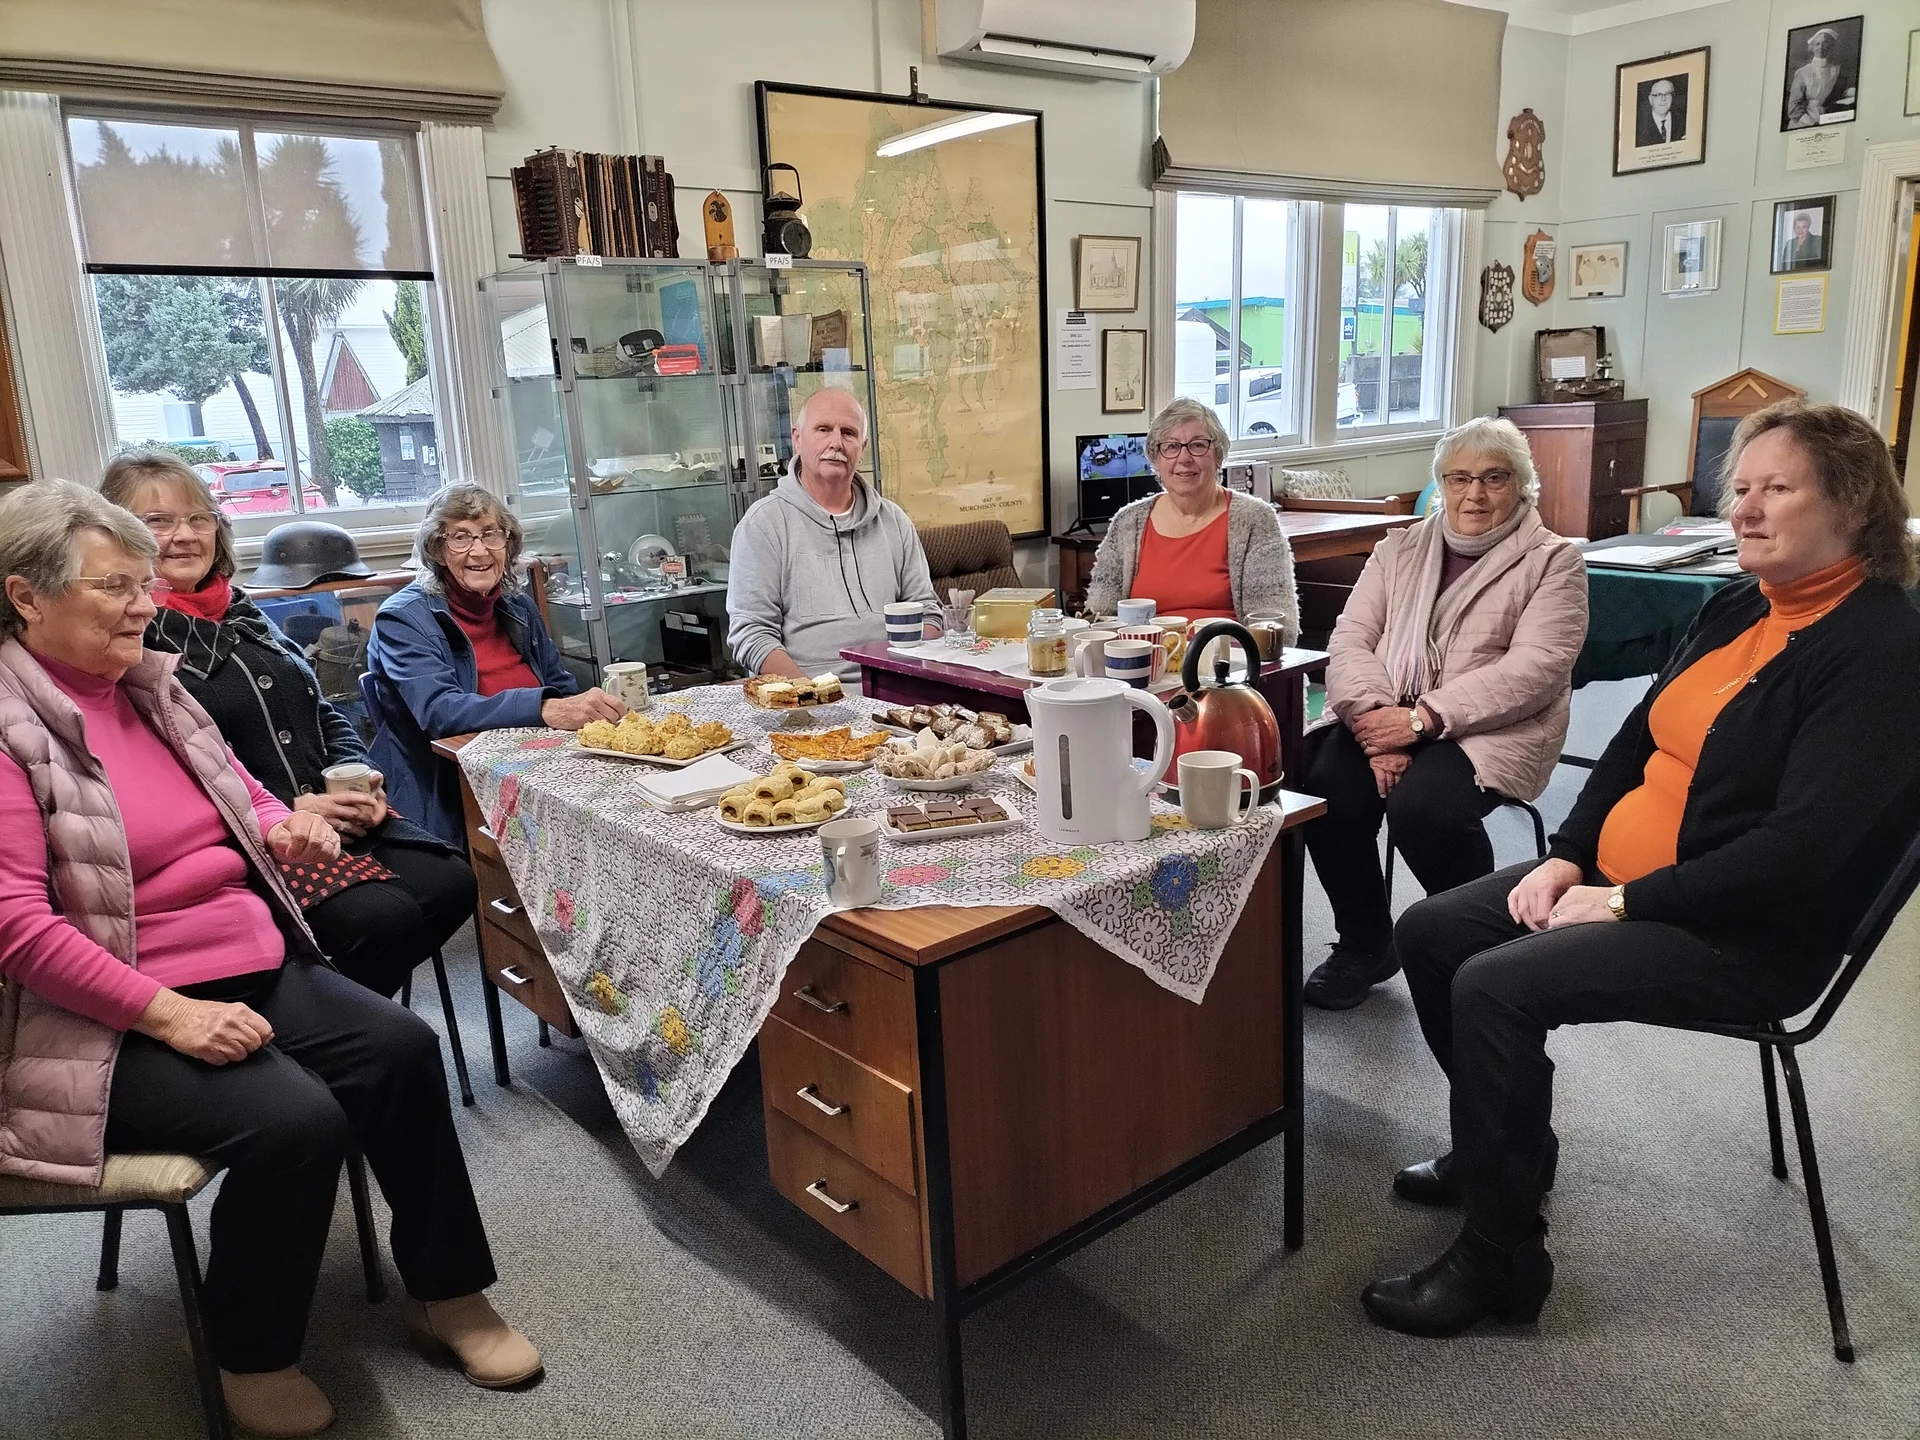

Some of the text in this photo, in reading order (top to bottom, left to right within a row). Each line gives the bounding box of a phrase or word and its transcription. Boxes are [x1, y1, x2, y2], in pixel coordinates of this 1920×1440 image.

[577, 256, 600, 266] PFA/S
[769, 256, 790, 265] PFA/S
[1344, 323, 1354, 333] sky
[959, 502, 996, 512] MURCHISON
